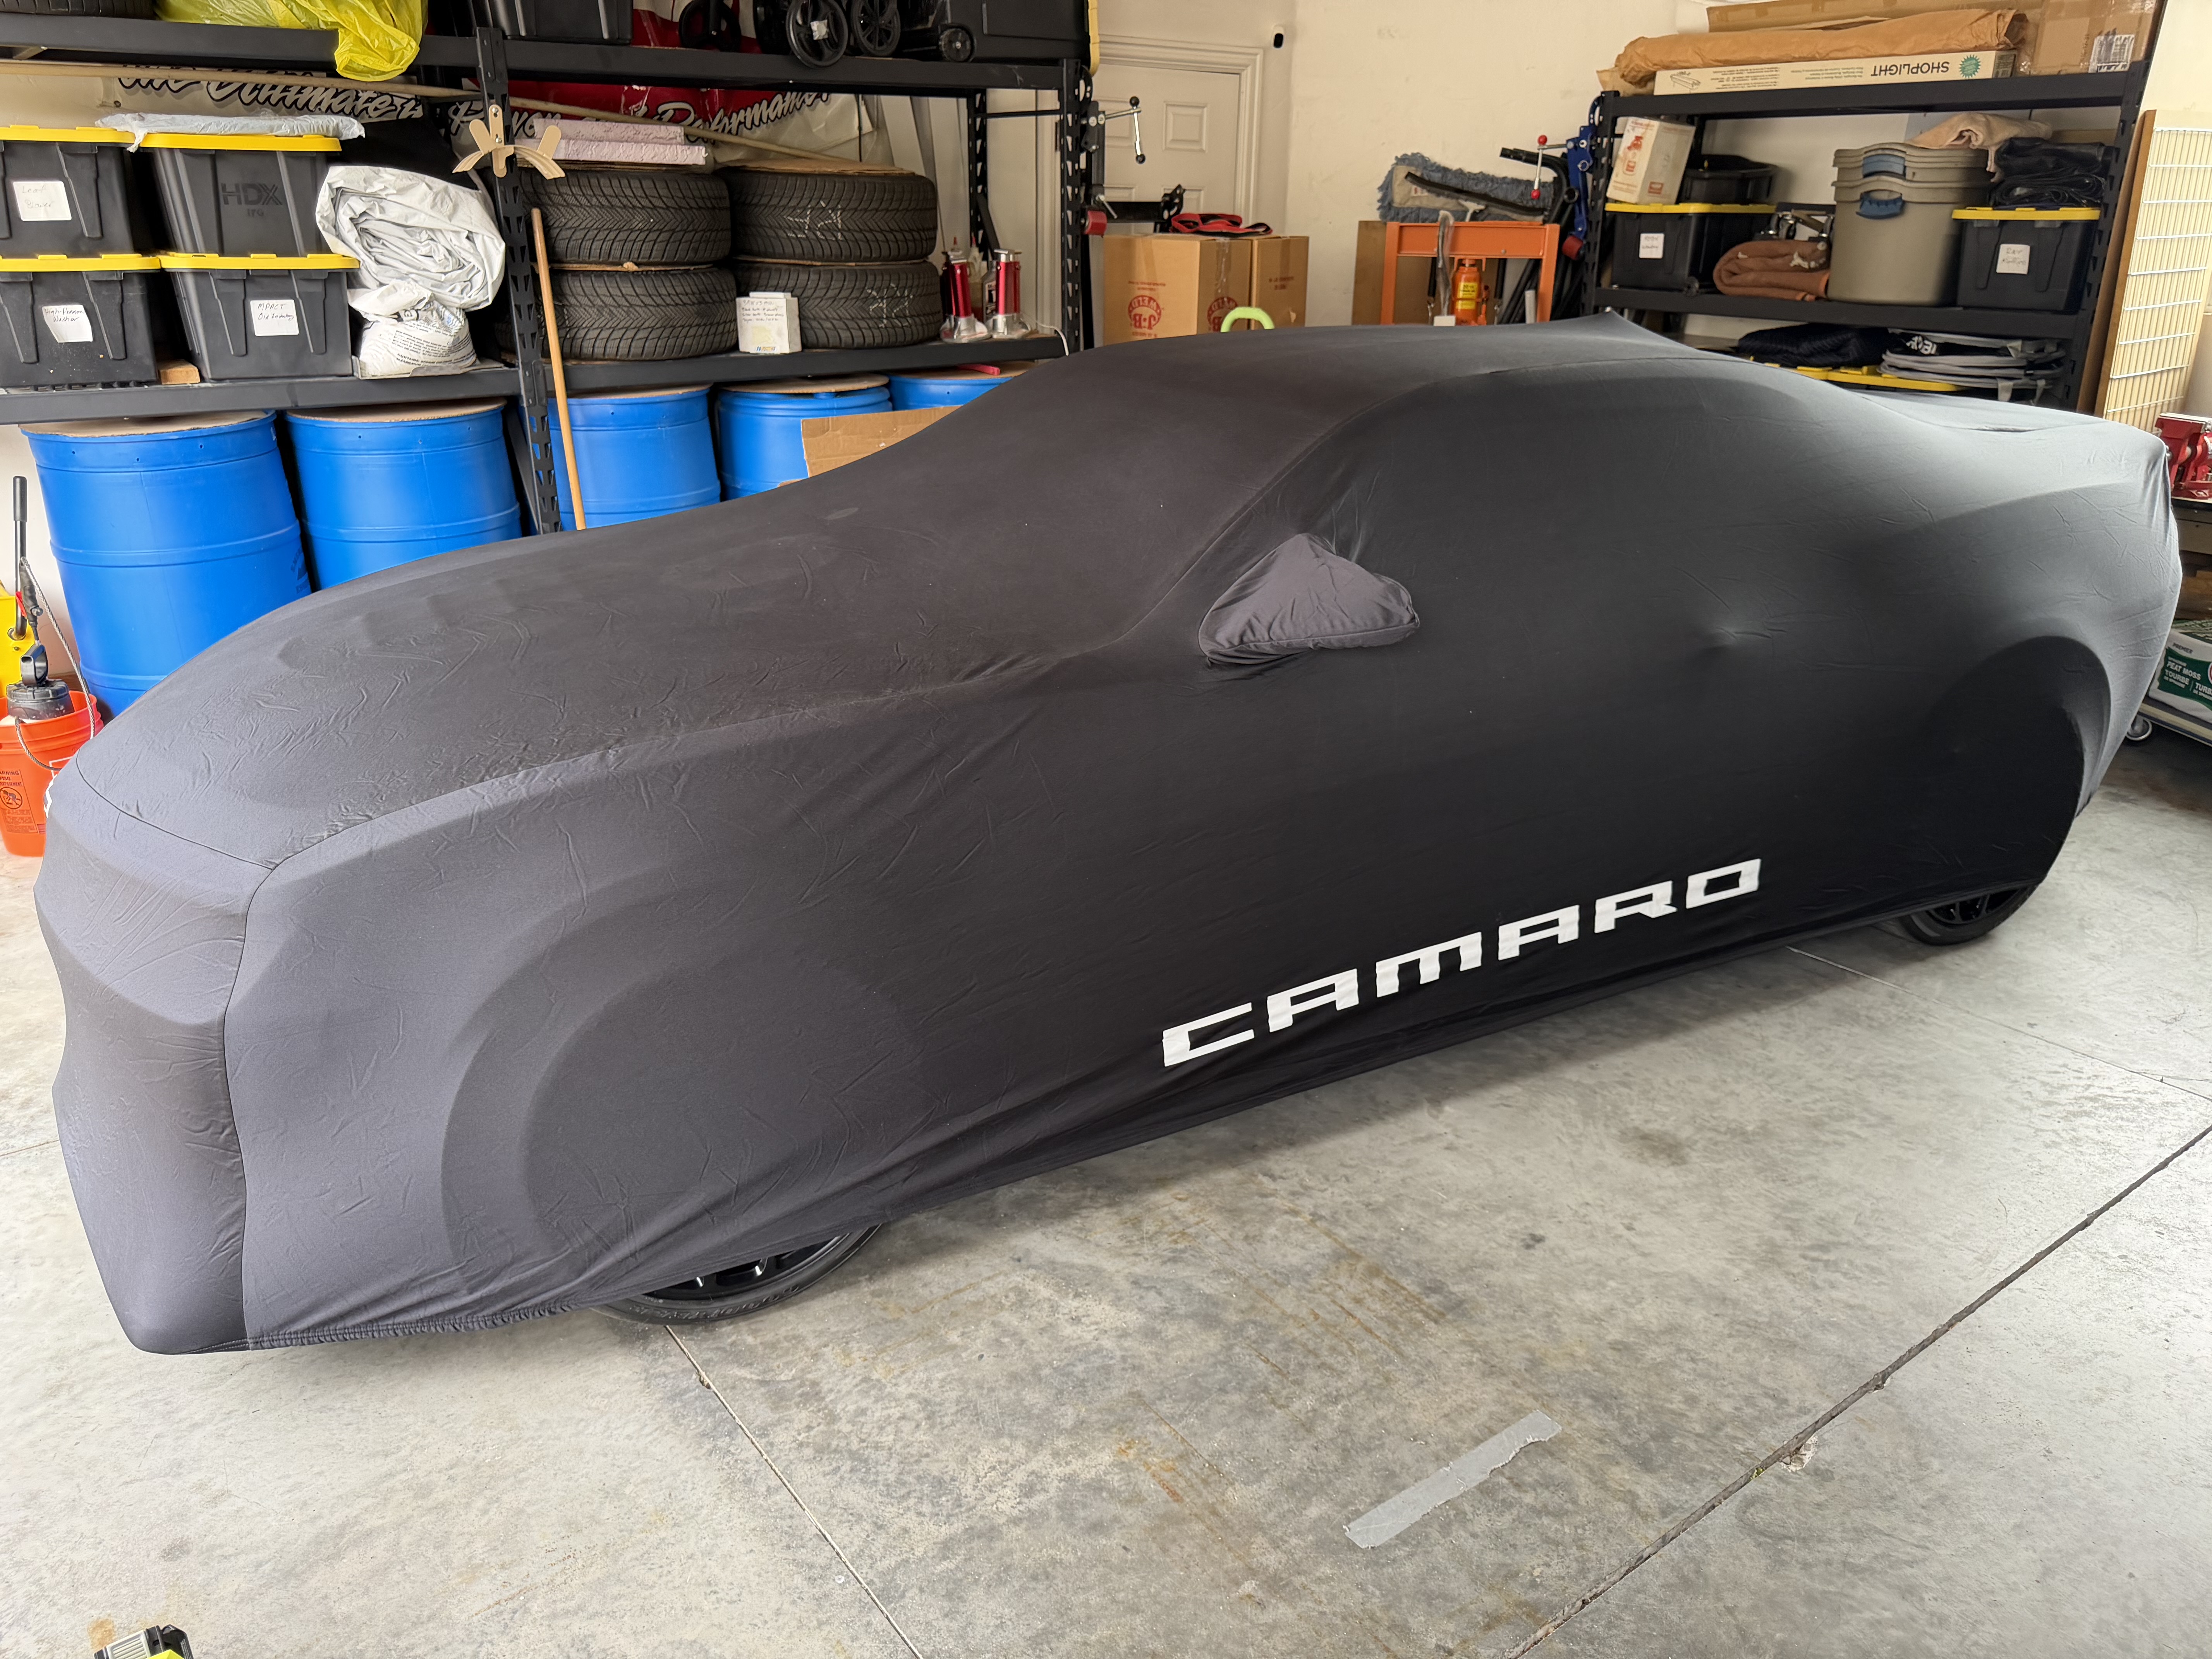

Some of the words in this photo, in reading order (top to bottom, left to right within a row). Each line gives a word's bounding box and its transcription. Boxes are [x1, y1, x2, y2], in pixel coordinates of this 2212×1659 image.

[1870, 61, 1950, 77] SHOPLIGHT
[221, 182, 283, 206] HDX
[1131, 296, 1157, 311] WELD
[2173, 643, 2193, 654] PREMIER
[2166, 661, 2183, 672] PEAT
[2182, 667, 2202, 680] MOSS
[2165, 669, 2190, 685] TOURBE
[2195, 682, 2212, 696] TURB
[1163, 858, 1762, 1066] CAMARO
